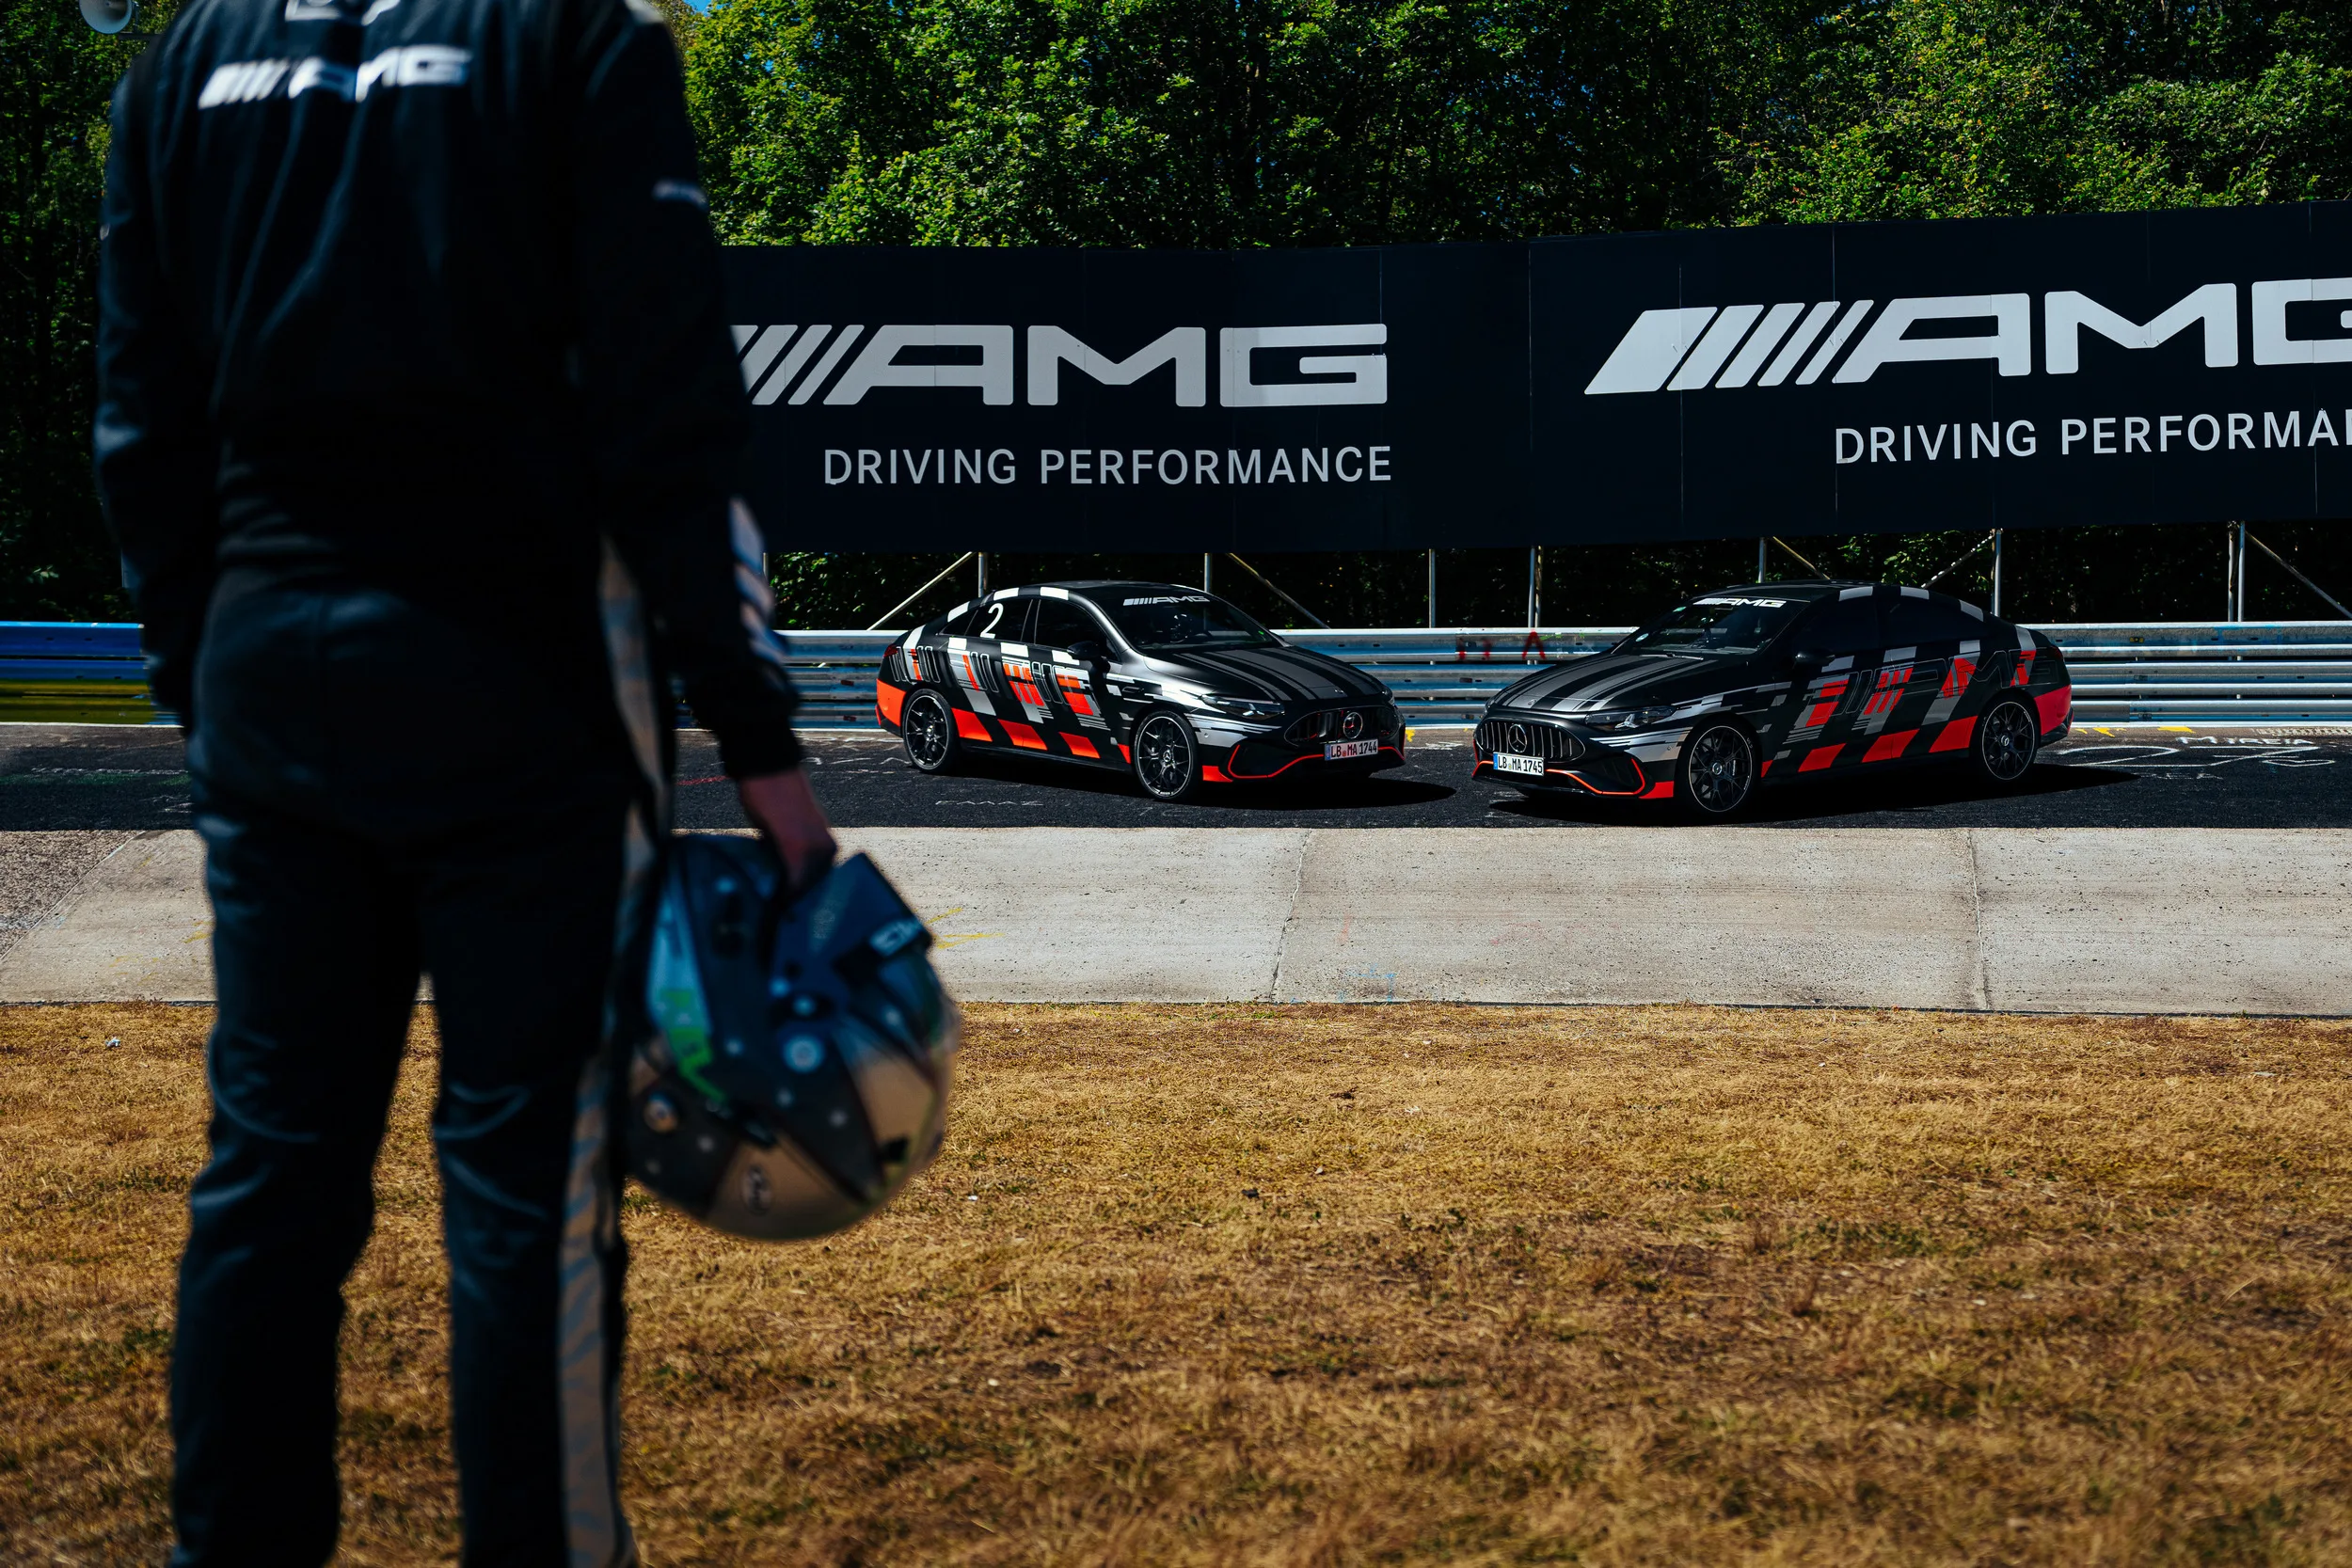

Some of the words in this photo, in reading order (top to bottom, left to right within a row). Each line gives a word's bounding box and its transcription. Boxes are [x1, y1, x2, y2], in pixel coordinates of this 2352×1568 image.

[823, 324, 1388, 407] AMG
[1836, 420, 2037, 465] DRIVING
[2061, 407, 2352, 455] PERFORMA
[824, 449, 1016, 485] DRIVING
[1041, 445, 1391, 485] PERFORMANCE
[979, 602, 1004, 640] 2
[1330, 745, 1342, 758] LB
[1347, 743, 1358, 756] MA
[1359, 741, 1377, 754] 1744
[1498, 755, 1507, 768] LB
[1512, 758, 1522, 771] MA
[1523, 760, 1543, 773] 1745
